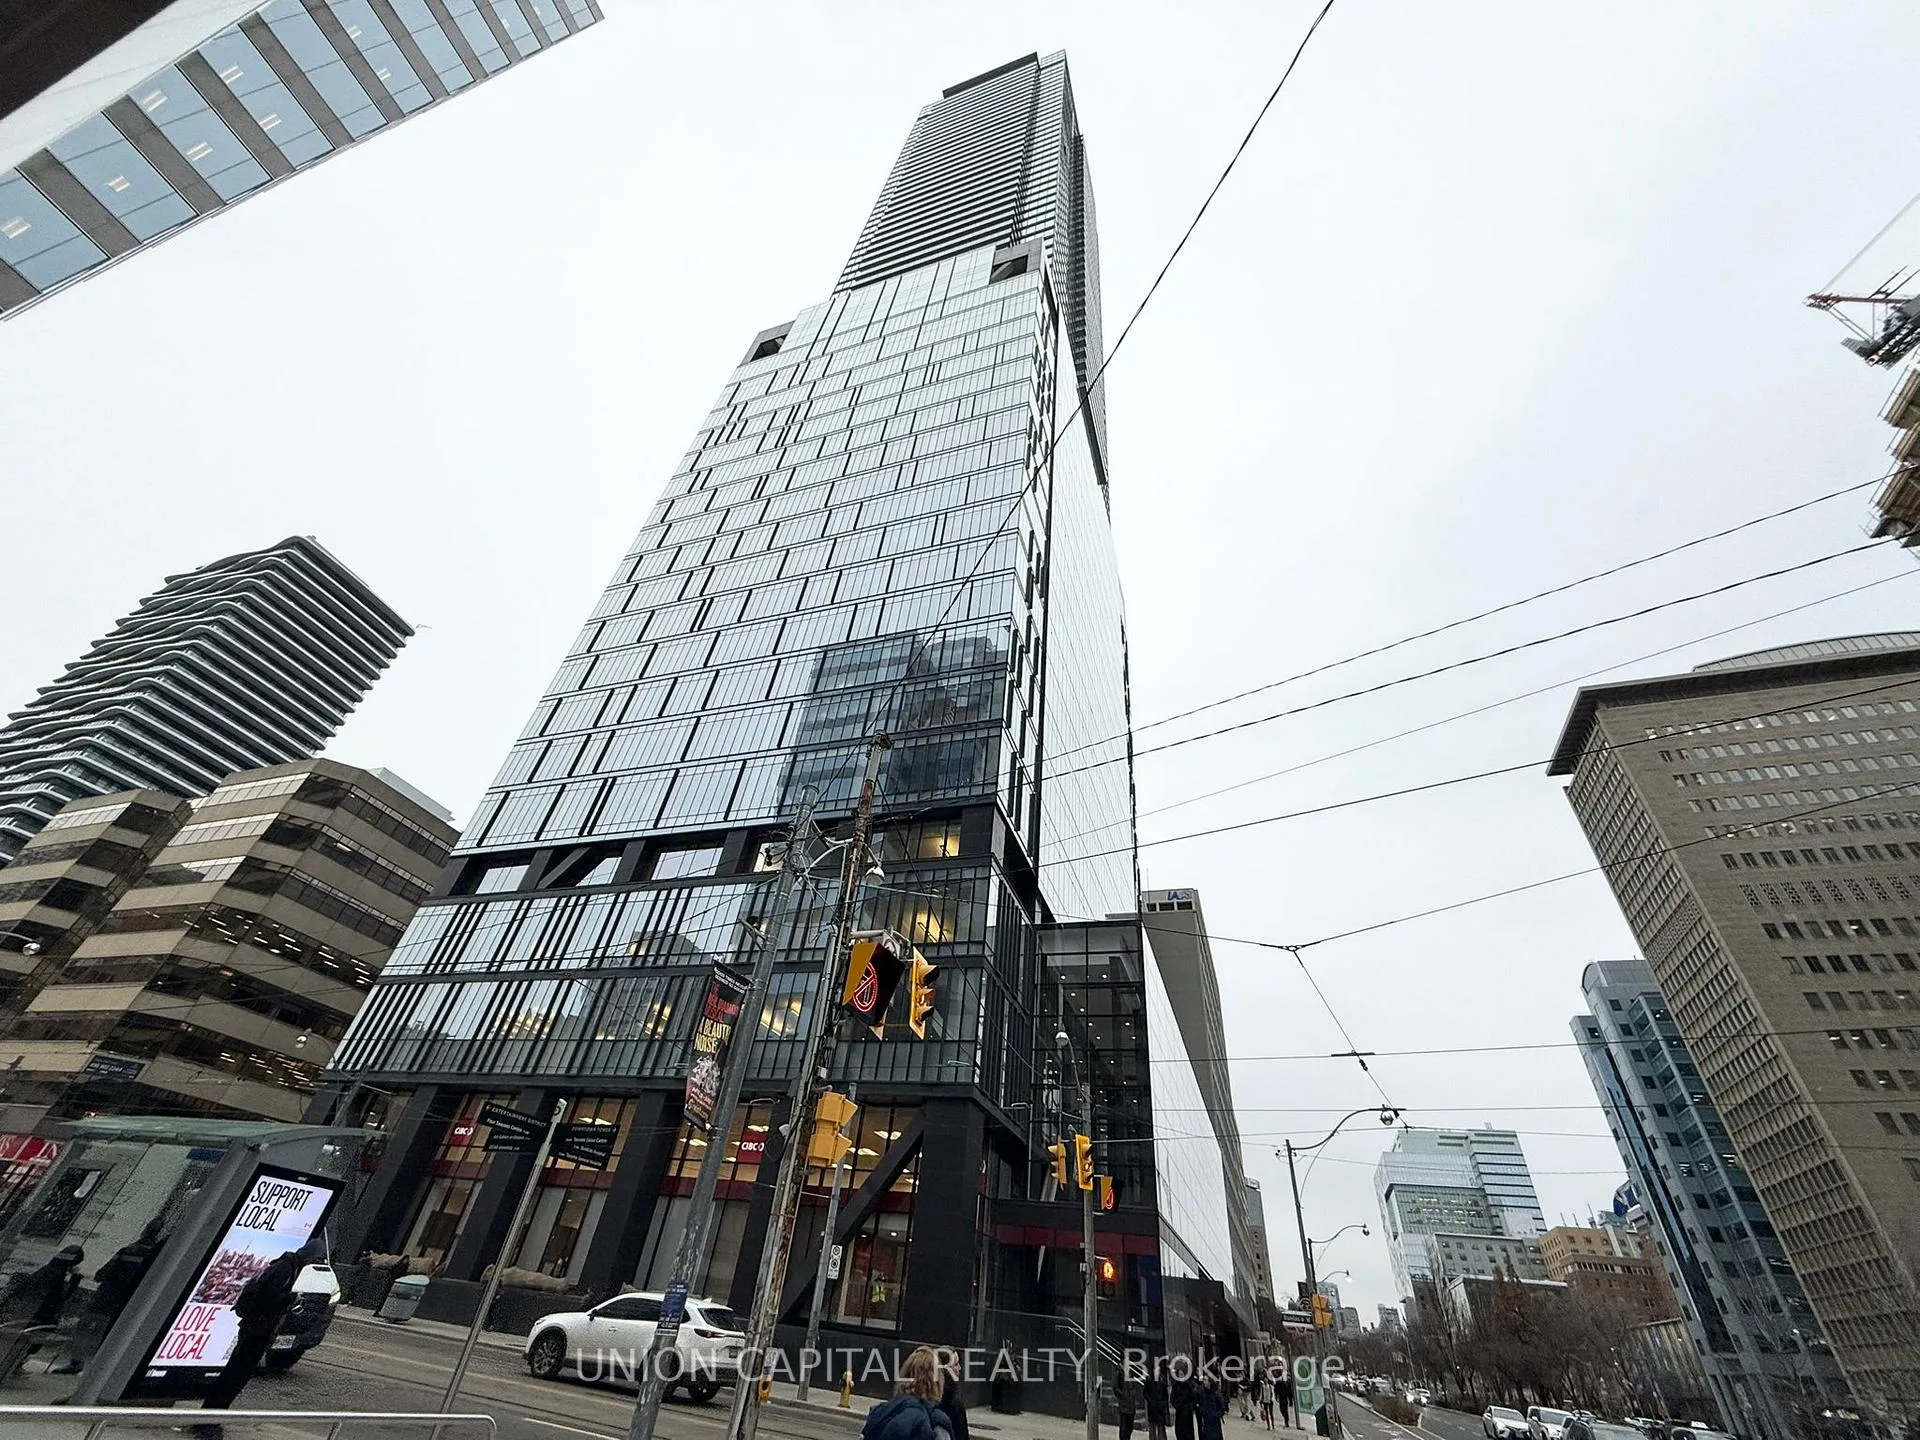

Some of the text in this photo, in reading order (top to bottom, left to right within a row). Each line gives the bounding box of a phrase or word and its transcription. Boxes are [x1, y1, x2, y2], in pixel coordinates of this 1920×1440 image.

[250, 1181, 314, 1212] SUPPORT
[235, 1204, 282, 1232] LOCAL
[174, 1305, 222, 1332] LOVE
[157, 1332, 212, 1360] LOCAL
